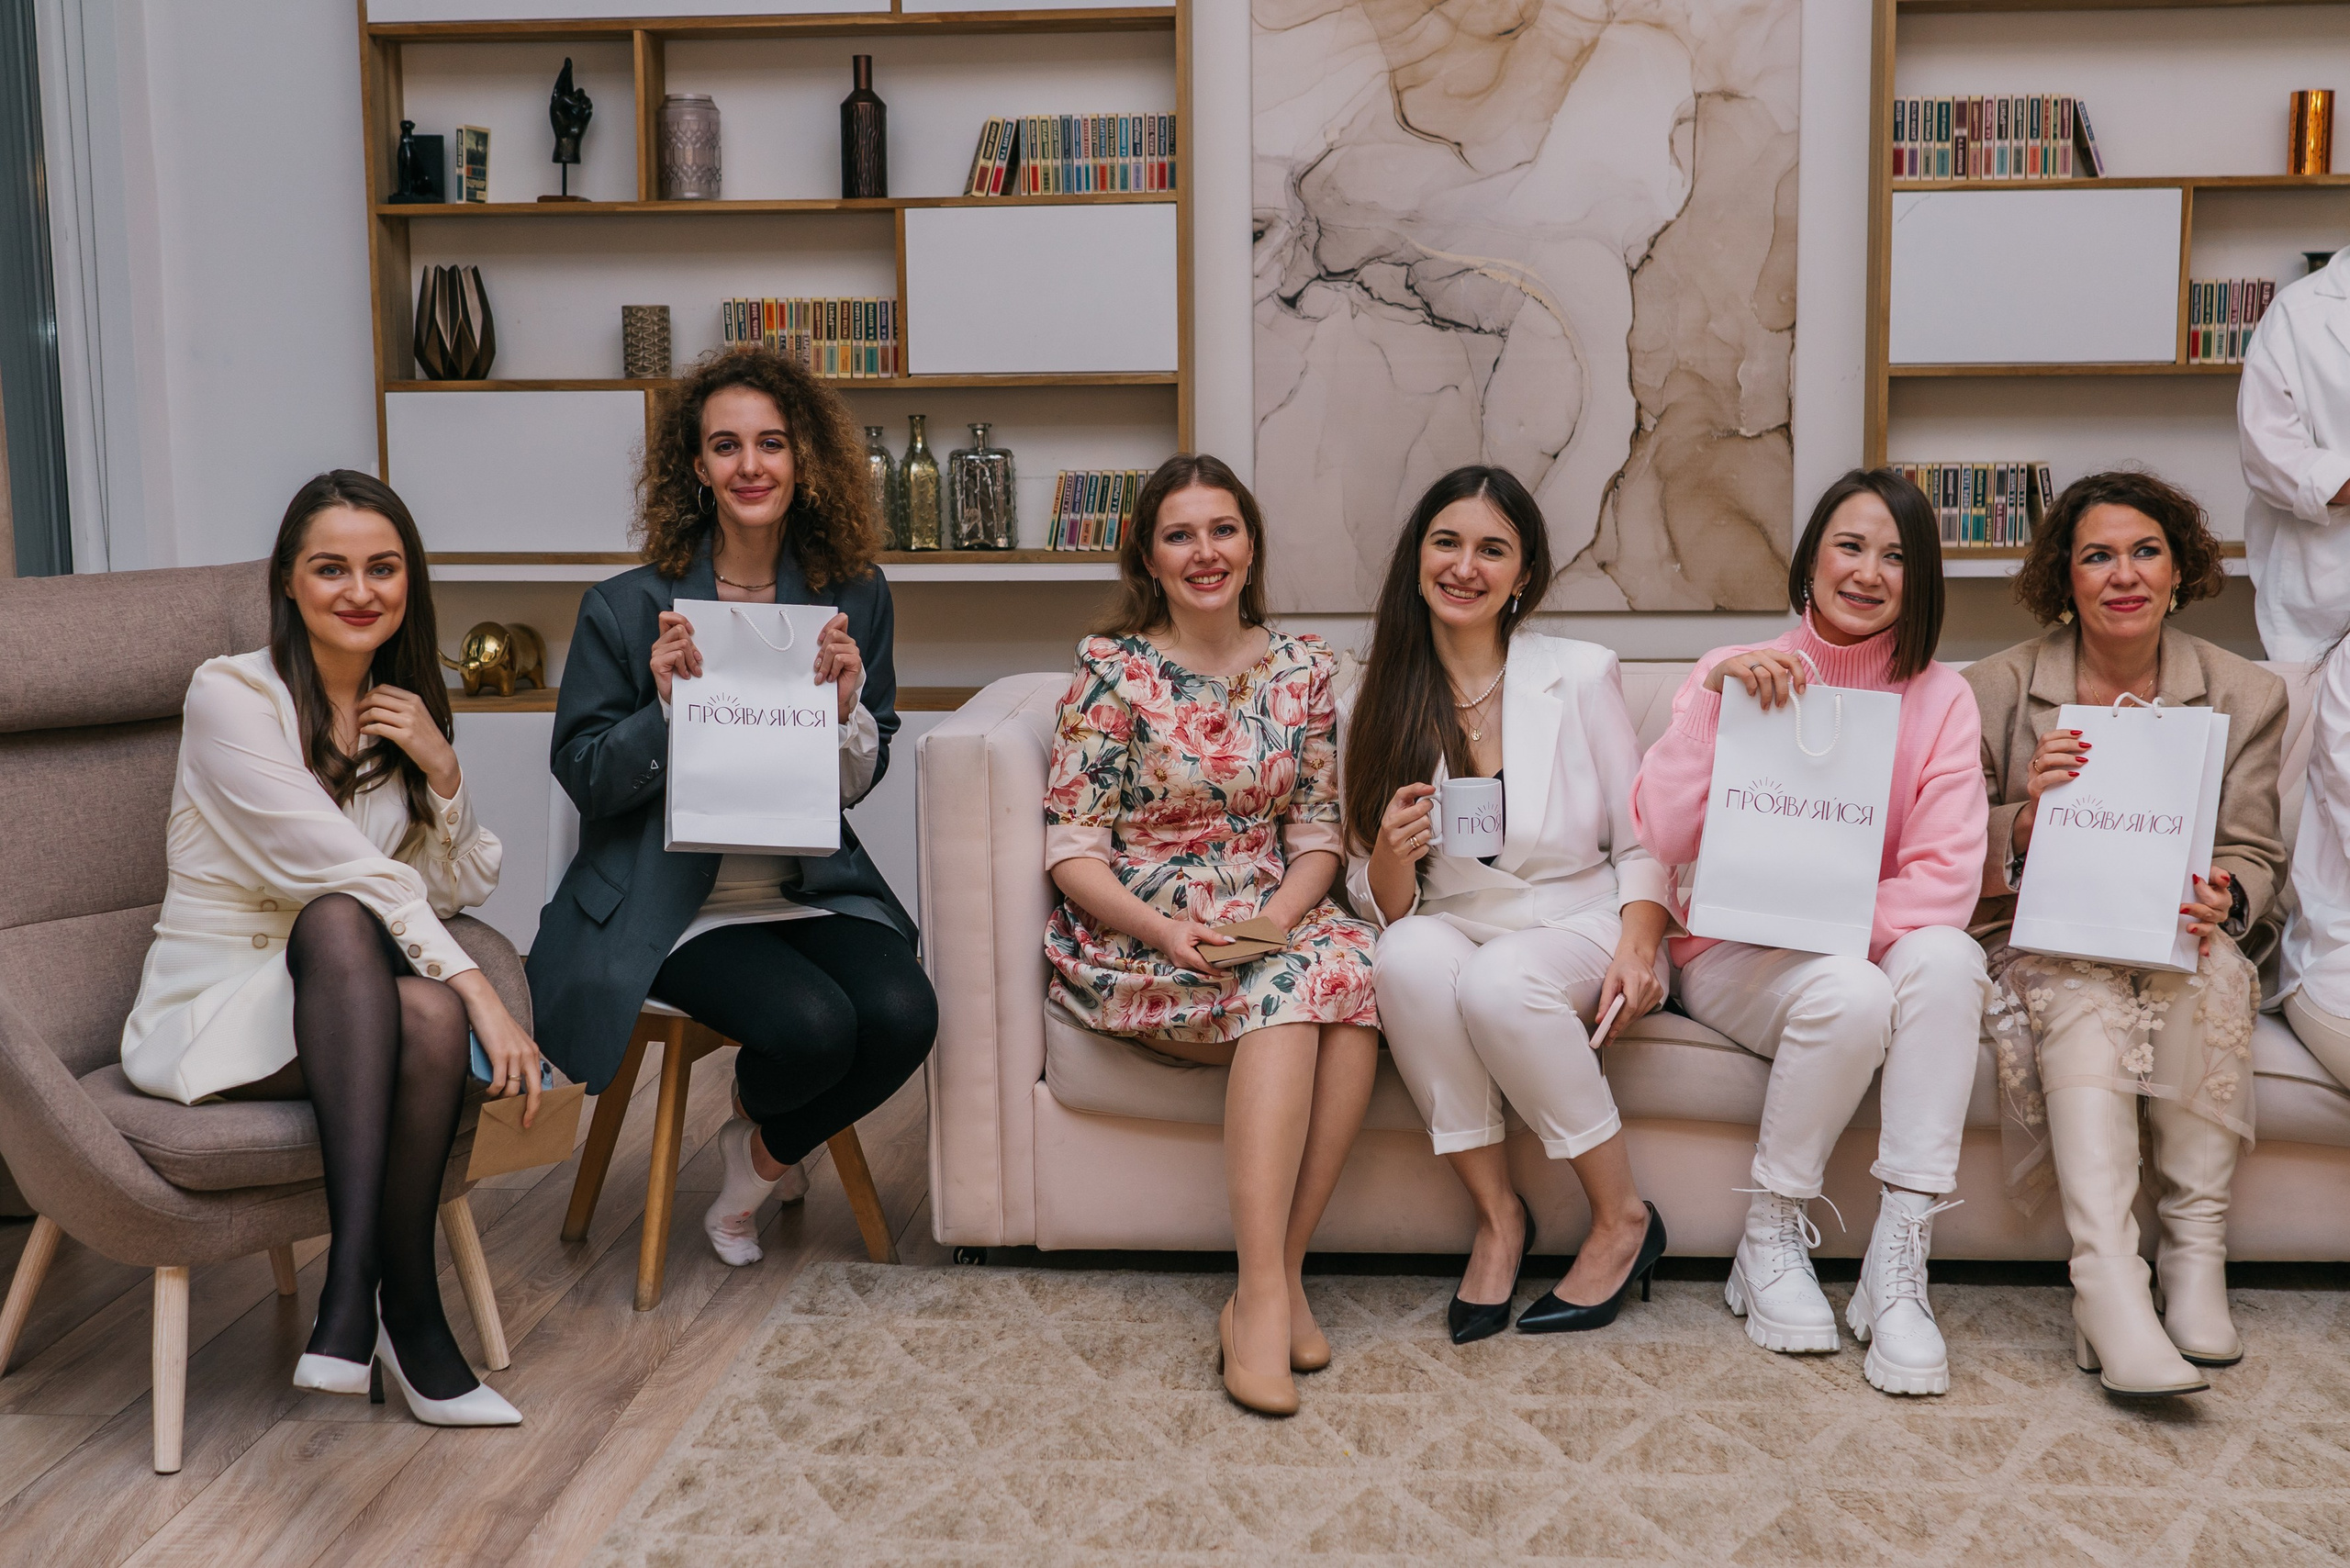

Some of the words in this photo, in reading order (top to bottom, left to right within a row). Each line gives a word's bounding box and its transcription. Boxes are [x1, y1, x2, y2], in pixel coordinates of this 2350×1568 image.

[688, 703, 826, 728] ПРОЯВЛЯЙСЯ
[1726, 788, 1874, 826] ПРОЯВЛЯЙСЯ
[2049, 806, 2184, 835] ПРОЯВЛЯЙСЯ
